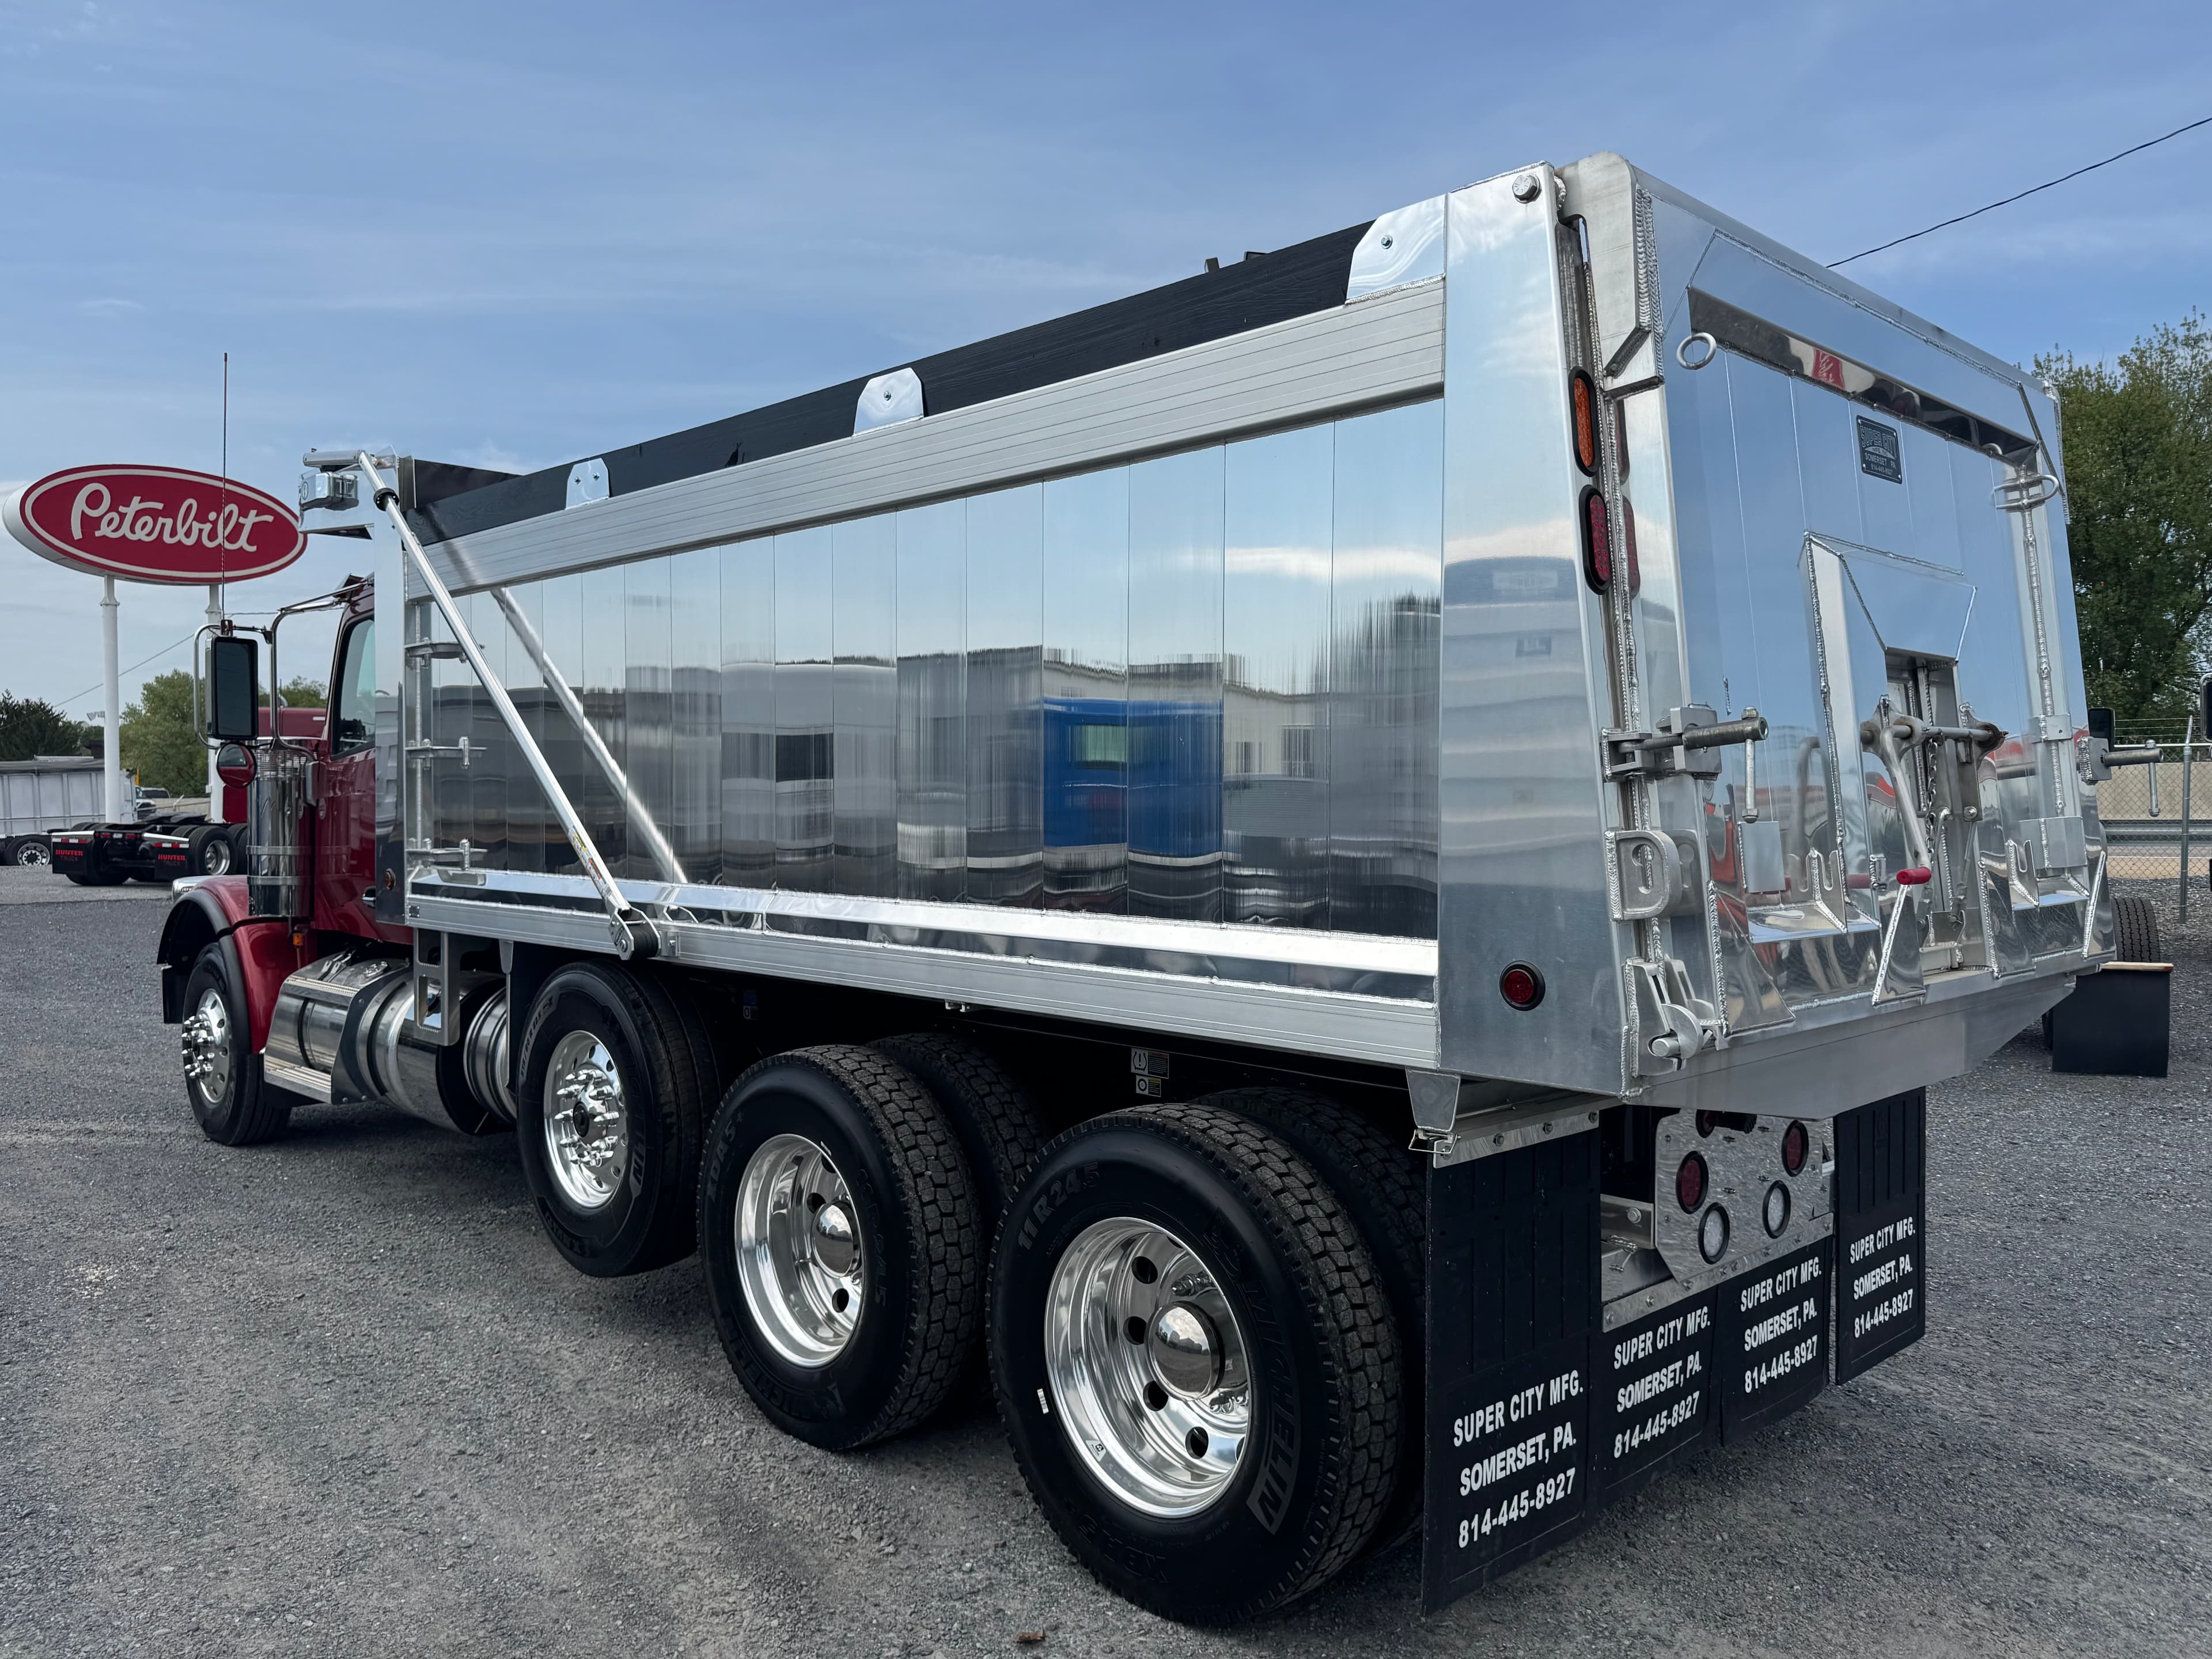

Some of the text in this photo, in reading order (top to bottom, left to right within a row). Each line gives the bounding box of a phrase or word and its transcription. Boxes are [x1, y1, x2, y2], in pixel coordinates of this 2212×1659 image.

[1865, 452, 1887, 465] SOMERSET
[70, 483, 274, 551] Peterbilt
[1850, 1217, 1916, 1264] SUPER CITY MFG.
[1740, 1256, 1821, 1312] SUPER CITY MFG.
[1854, 1254, 1913, 1300] SOMERSET, PA.
[1613, 1306, 1710, 1369] SUPER CITY MFG.
[1744, 1297, 1817, 1351] SOMERSET, PA.
[1854, 1288, 1913, 1338] 814-445-8927
[1617, 1351, 1702, 1412] SOMERSET, PA.
[1745, 1334, 1817, 1393] 814-445-8927
[1243, 1279, 1296, 1531] MICHELIN
[1453, 1370, 1584, 1447] SUPER CITY MFG.
[1613, 1391, 1700, 1459] 814-445-8927
[1460, 1422, 1577, 1496] SOMERSET, PA.
[1459, 1467, 1575, 1548] 814-445-8927
